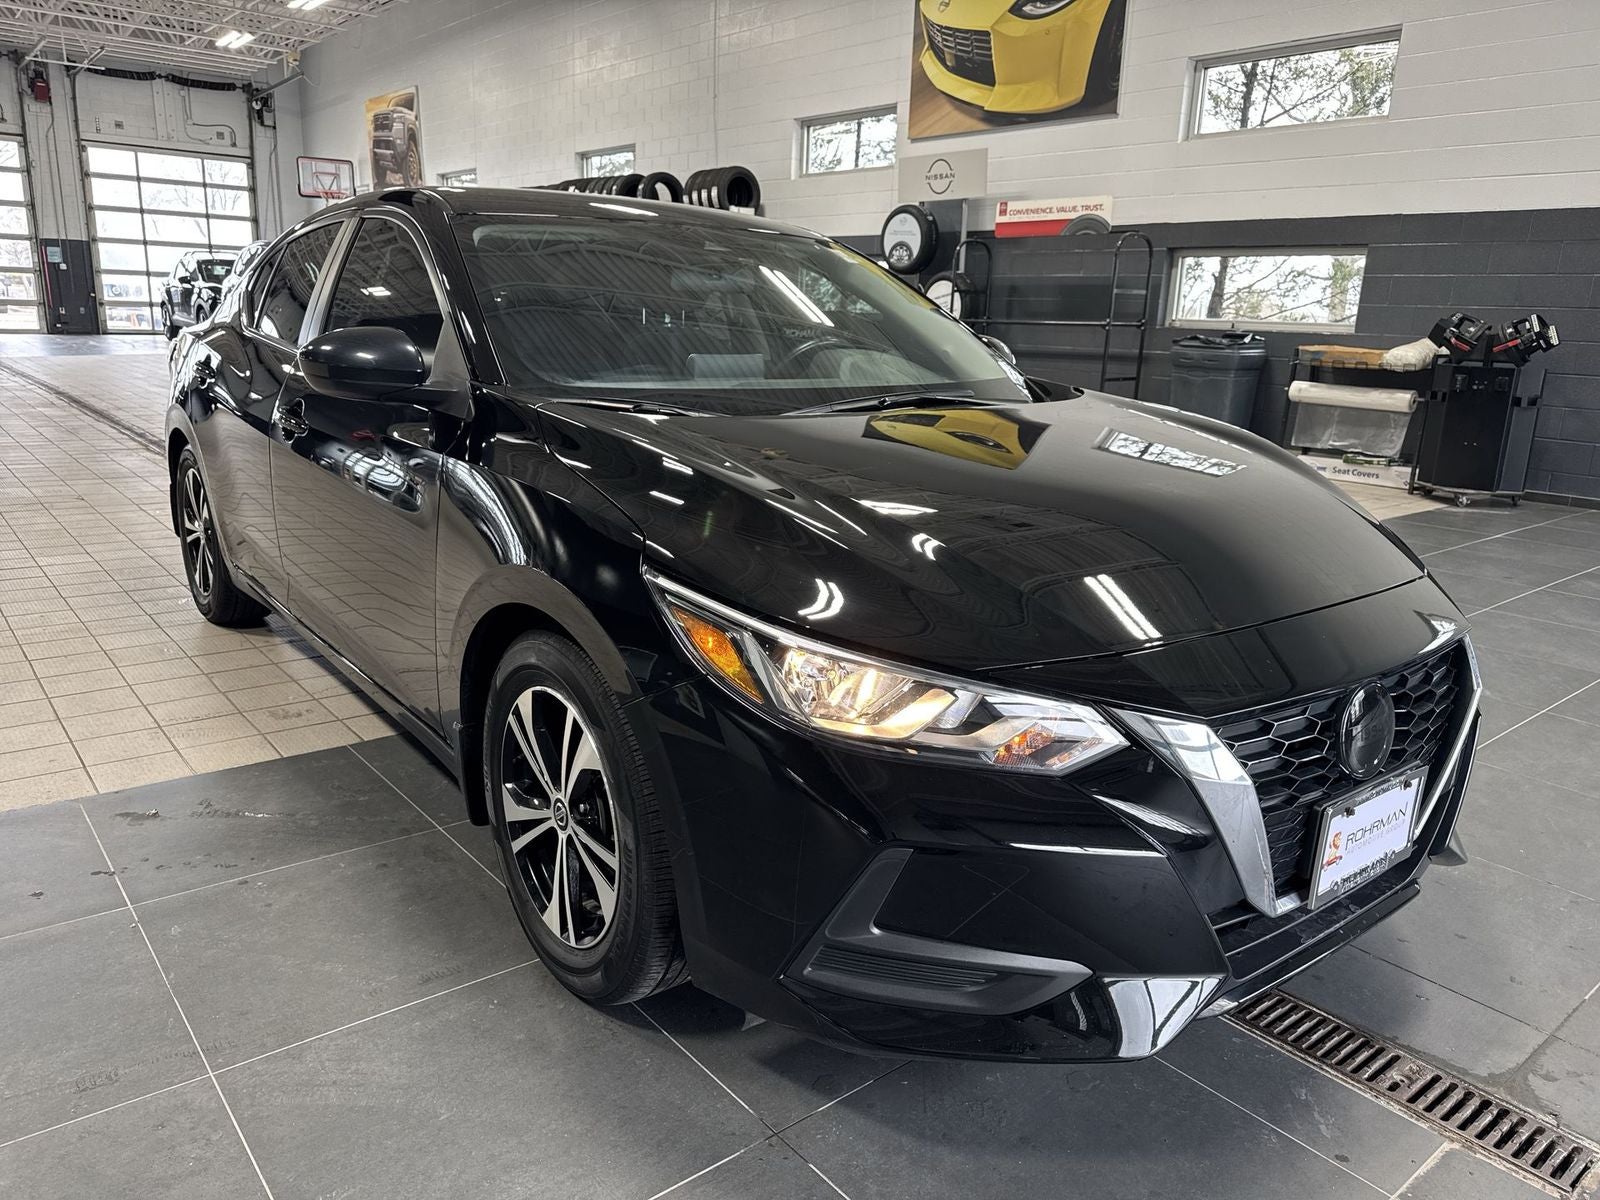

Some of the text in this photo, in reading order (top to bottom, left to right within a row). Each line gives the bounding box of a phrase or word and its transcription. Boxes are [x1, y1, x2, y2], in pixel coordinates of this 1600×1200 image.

[925, 172, 956, 181] NISSAN
[1008, 206, 1055, 217] CONVENIENCE.
[1056, 205, 1079, 214] VALUE.
[1080, 203, 1105, 213] TRUST.
[1332, 466, 1351, 476] Seat
[1351, 468, 1380, 479] Covers
[1344, 801, 1409, 851] ROHRMAN
